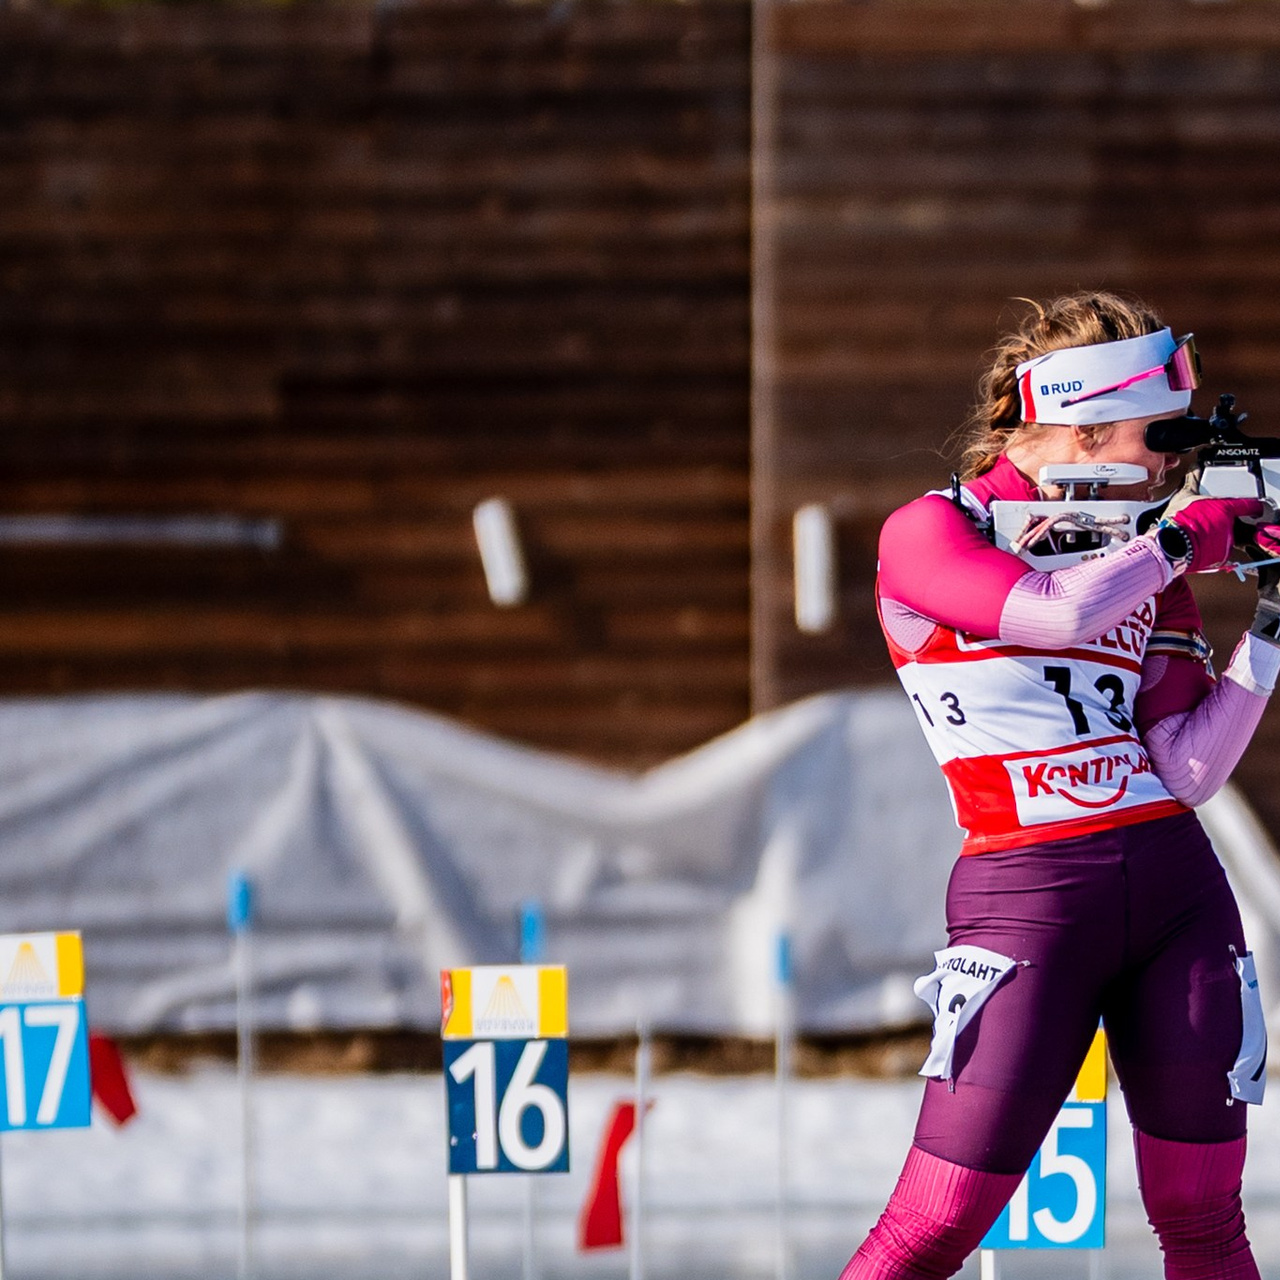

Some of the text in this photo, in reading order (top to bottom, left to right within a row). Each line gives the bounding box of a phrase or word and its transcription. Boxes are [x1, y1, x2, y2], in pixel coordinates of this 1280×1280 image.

[1051, 380, 1083, 395] RUD
[912, 691, 967, 728] 13
[1043, 665, 1132, 736] 13
[0, 1005, 80, 1126] 17
[448, 1039, 567, 1170] 16
